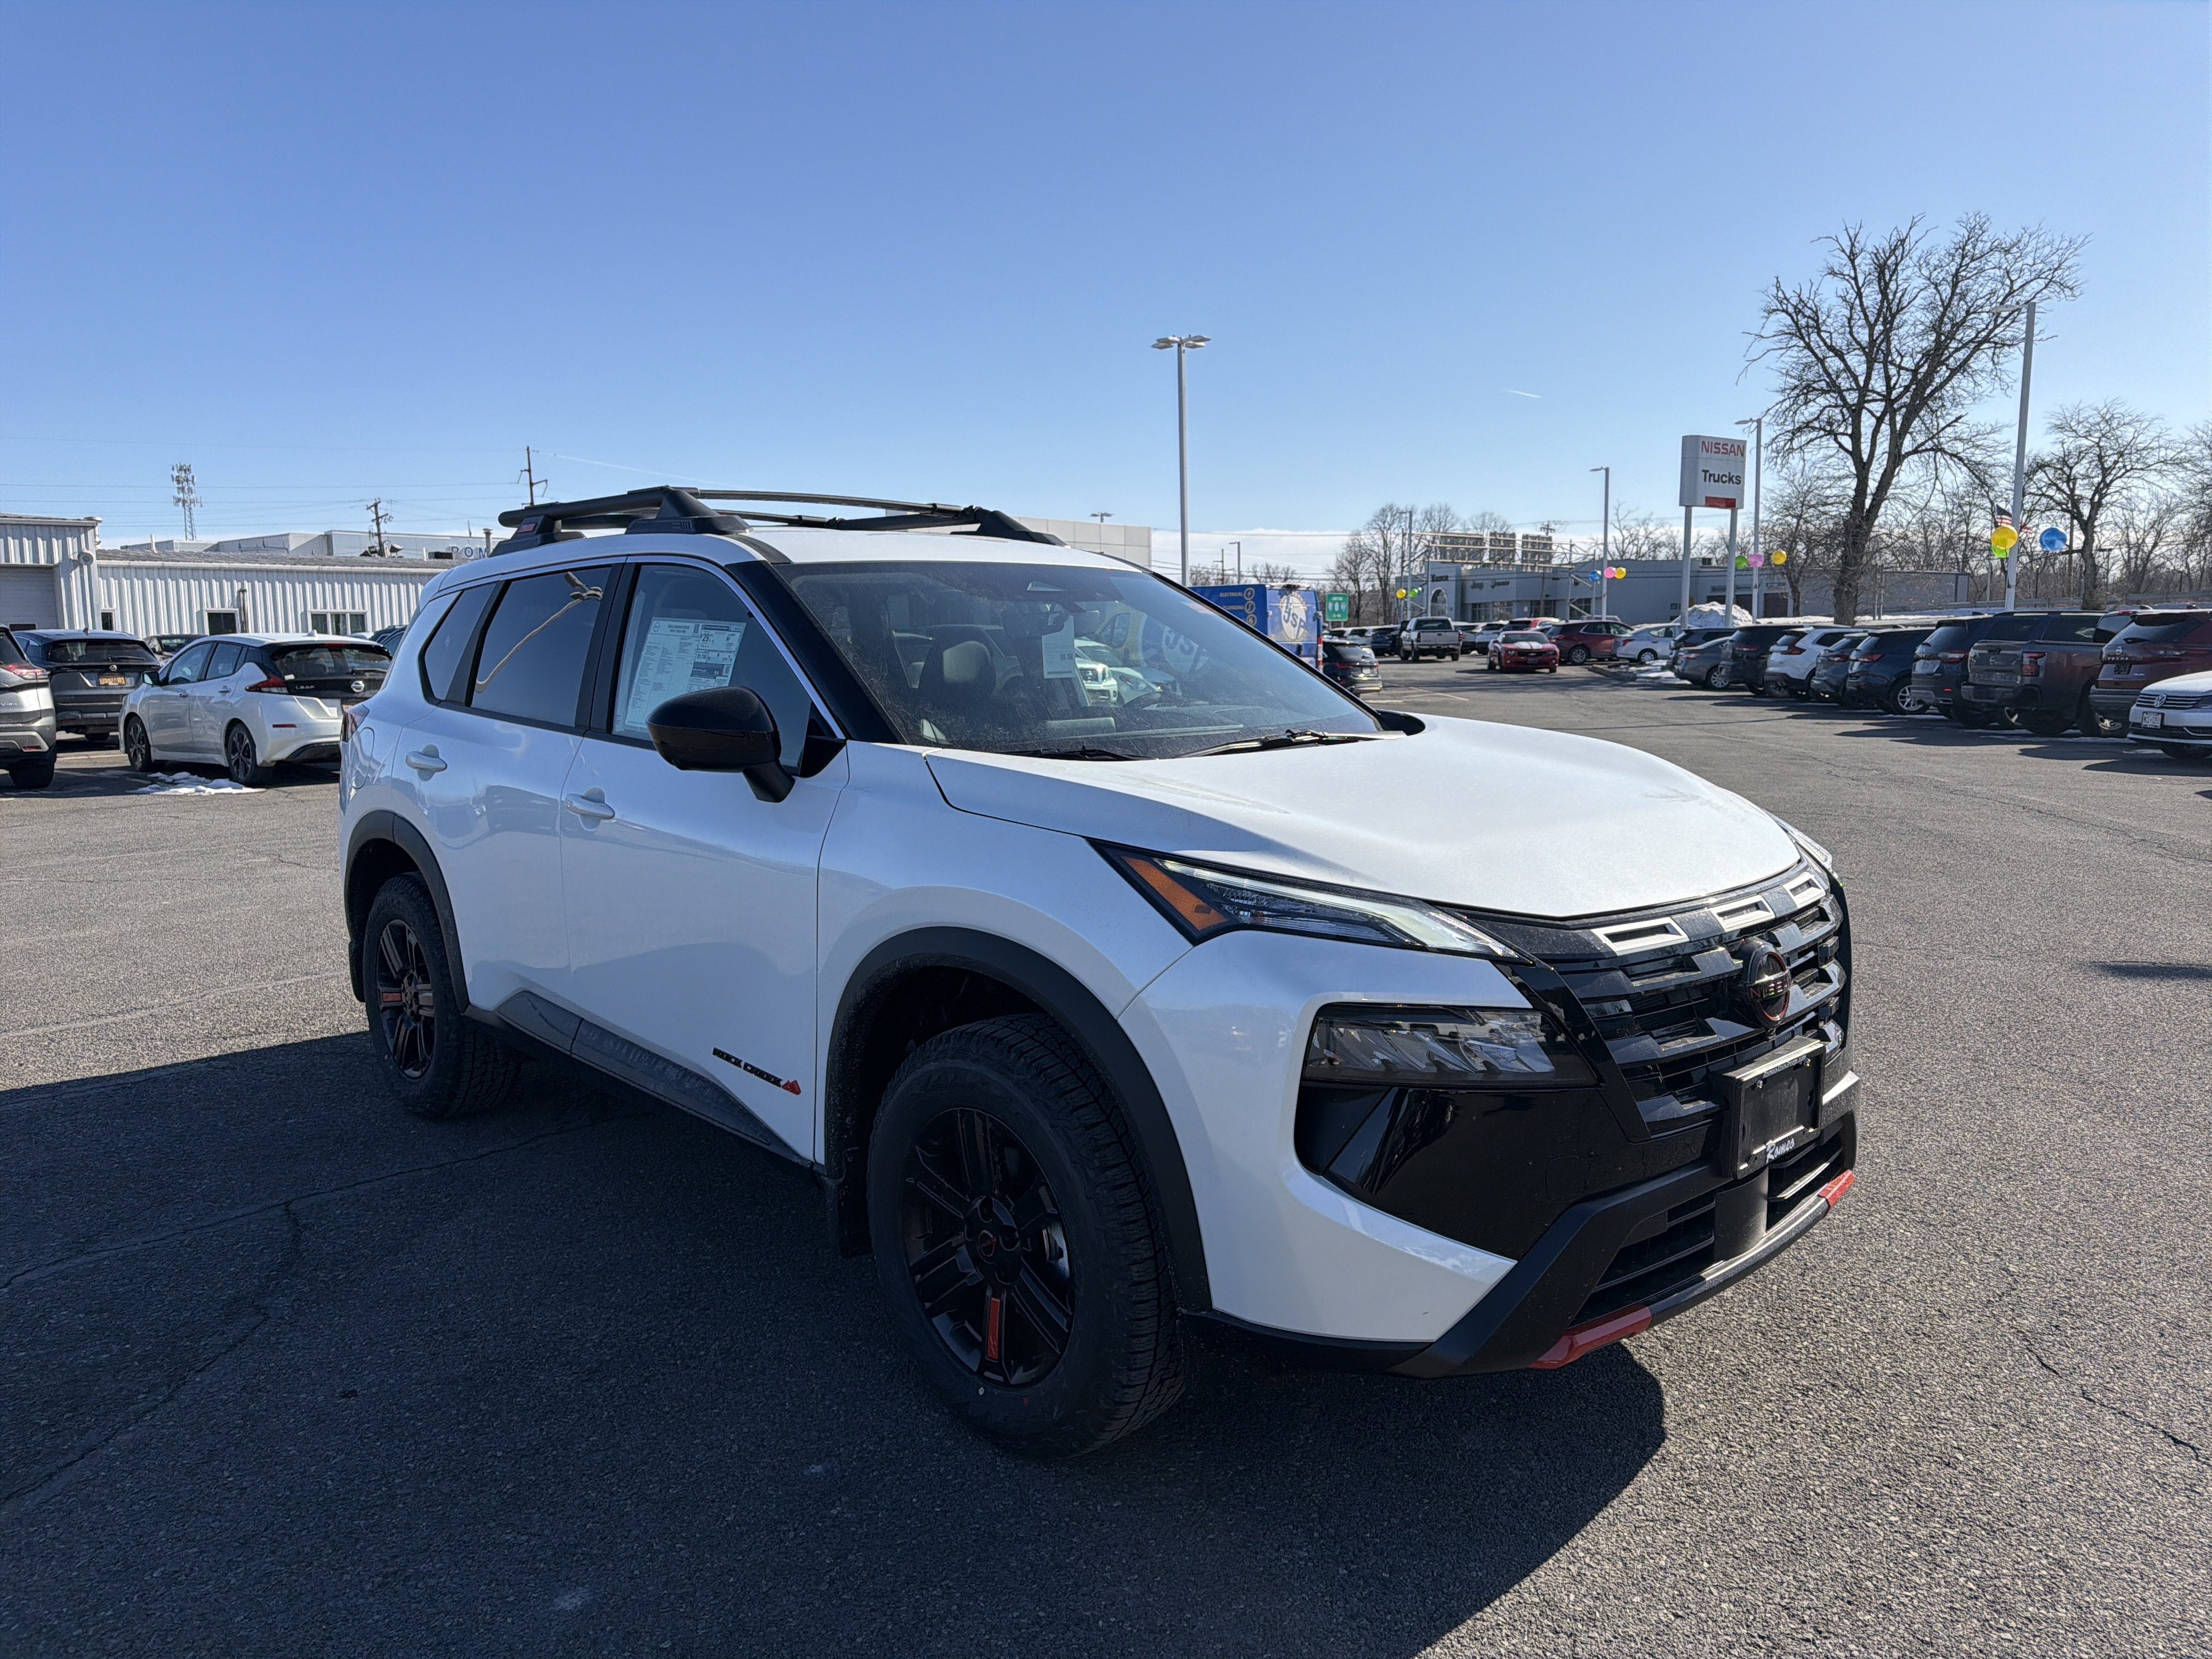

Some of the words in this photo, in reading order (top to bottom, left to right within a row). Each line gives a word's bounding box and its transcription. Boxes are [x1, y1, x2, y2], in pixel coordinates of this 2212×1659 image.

[1701, 441, 1745, 456] NISSAN
[1702, 470, 1742, 485] Trucks
[713, 1047, 743, 1068] ROCK
[743, 1062, 783, 1087] CREEK
